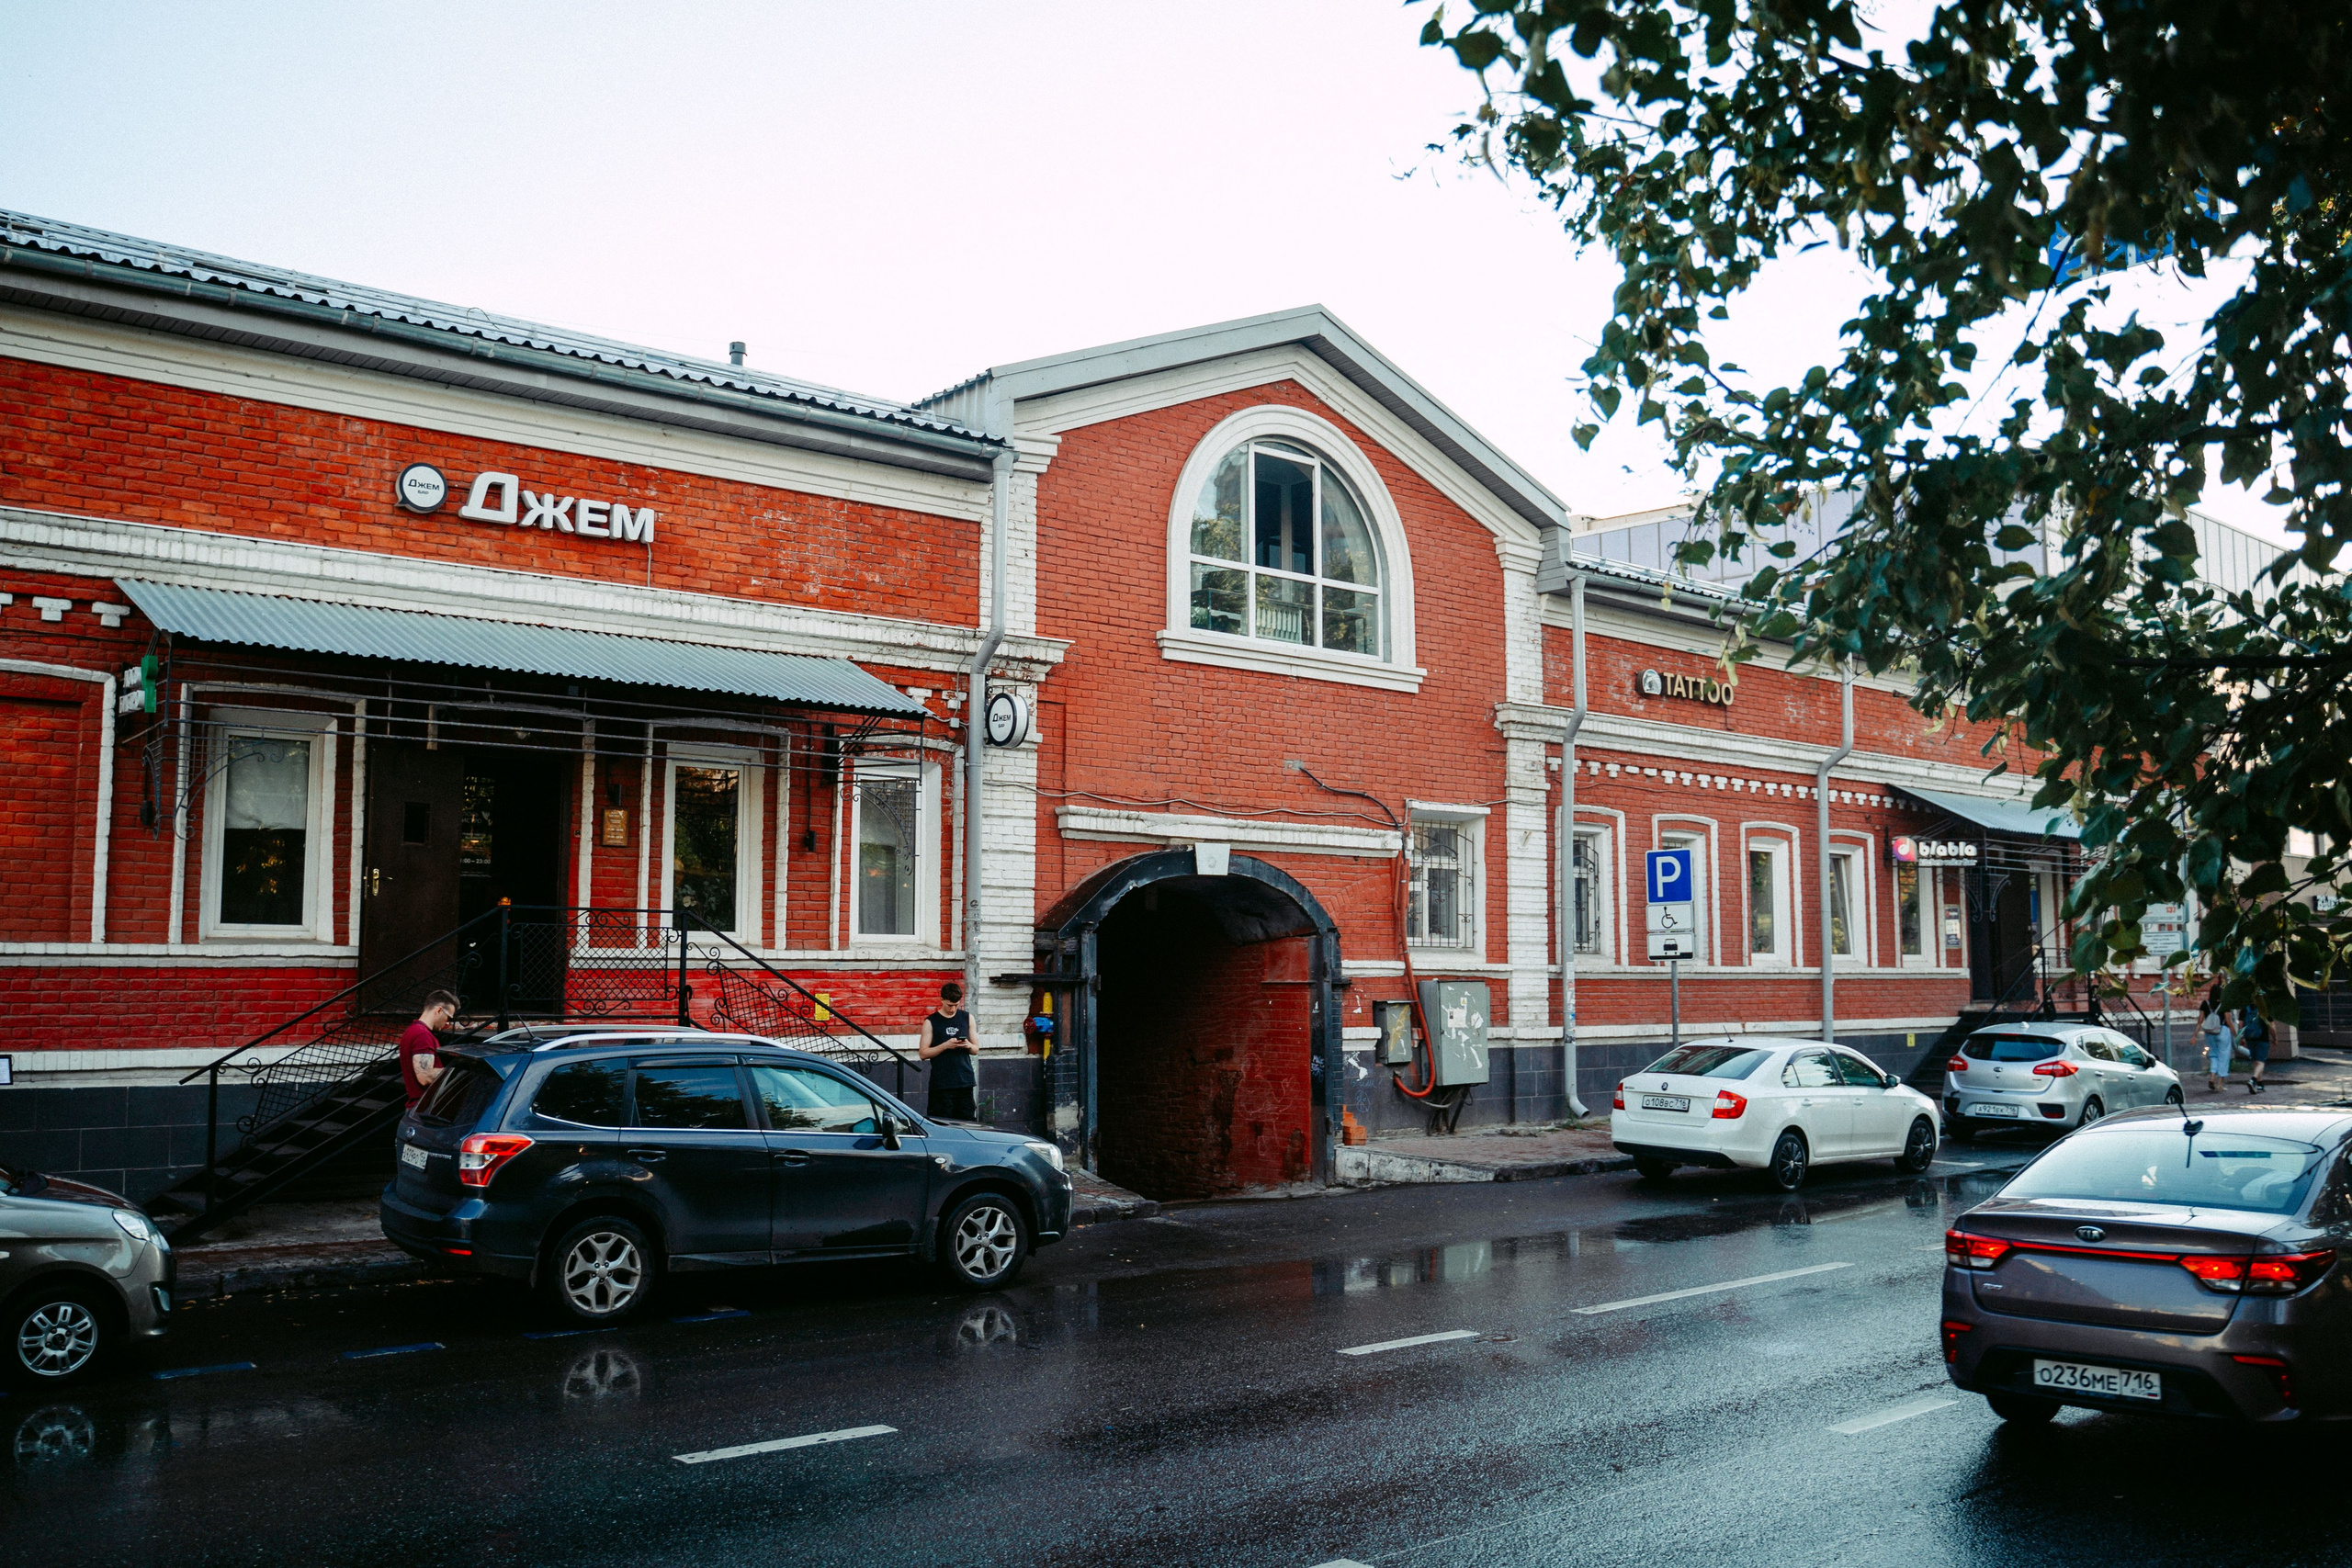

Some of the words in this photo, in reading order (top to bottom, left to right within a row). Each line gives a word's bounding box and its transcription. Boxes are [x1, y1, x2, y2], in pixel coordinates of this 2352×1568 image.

[408, 479, 440, 491] ДЖЕМ
[1663, 671, 1735, 705] TATTOO
[1918, 840, 1977, 857] blabla
[1656, 856, 1681, 897] P
[2120, 1371, 2154, 1390] 716
